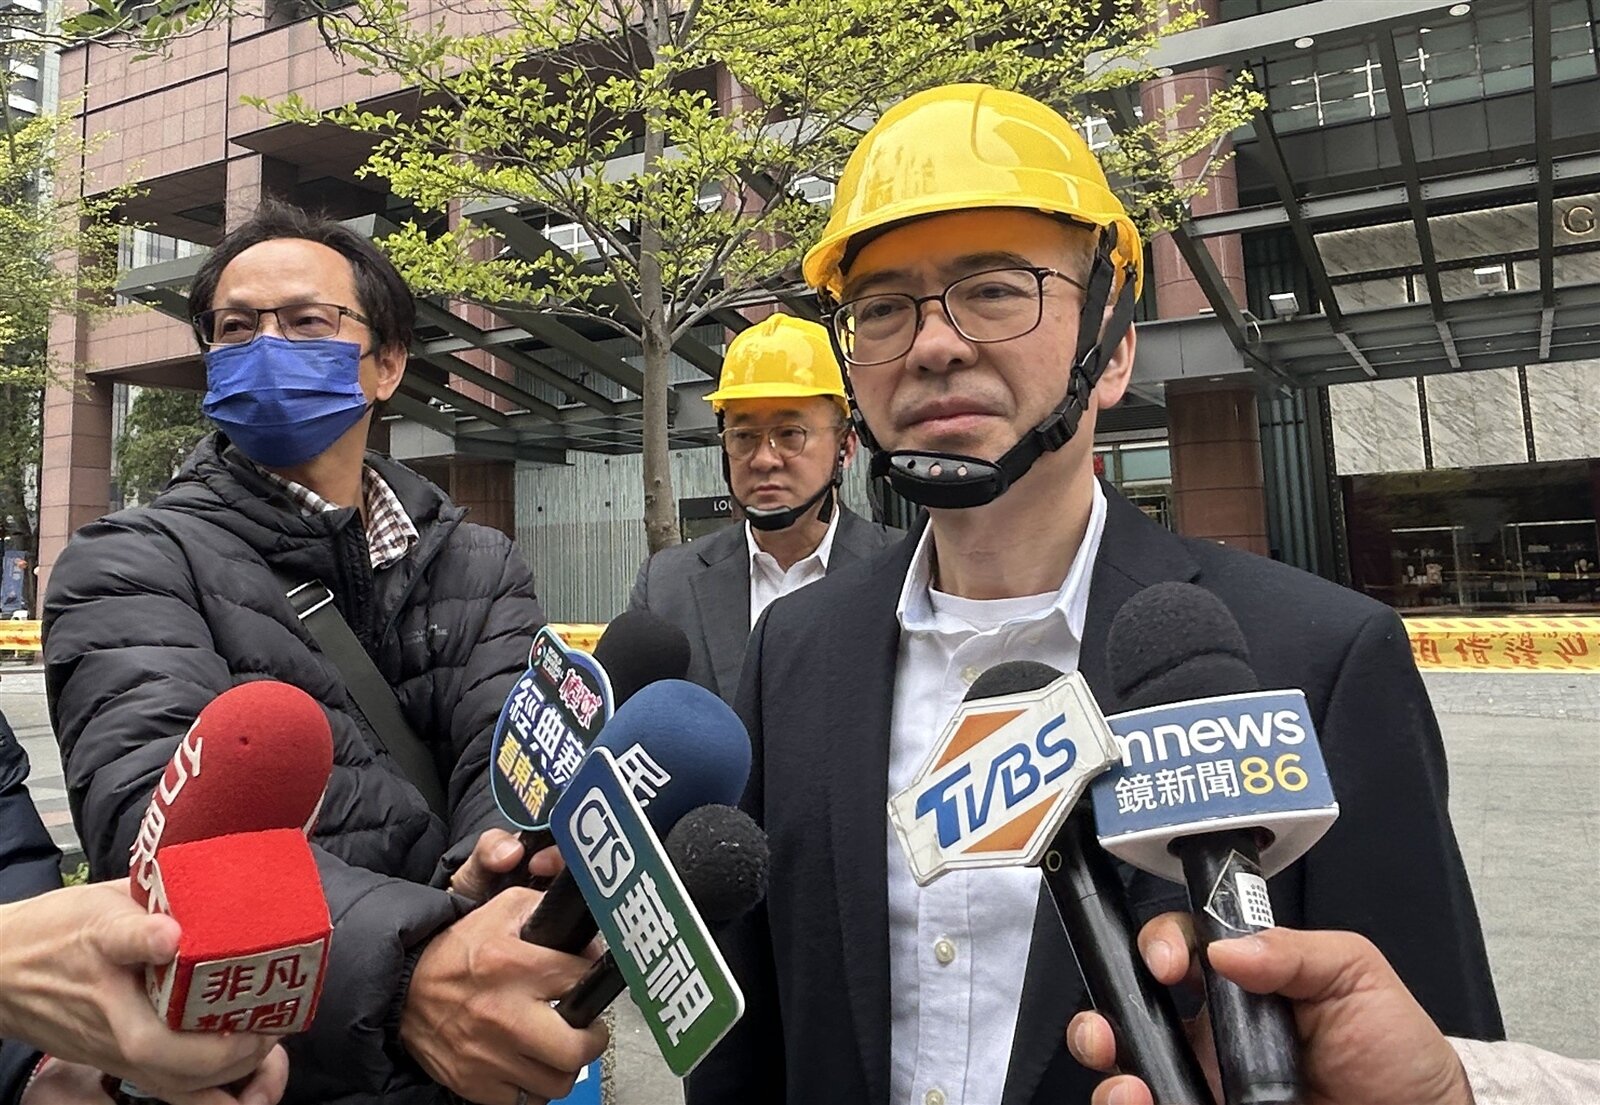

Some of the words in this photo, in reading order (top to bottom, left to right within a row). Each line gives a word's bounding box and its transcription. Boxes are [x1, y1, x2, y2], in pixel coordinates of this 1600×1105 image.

[558, 668, 602, 730] 棒球
[496, 730, 549, 822] 看東森
[1113, 710, 1306, 768] mnews
[915, 712, 1077, 849] TVBS
[576, 799, 631, 889] CTS
[612, 870, 714, 1047] 華視
[201, 954, 307, 1004] 非凡
